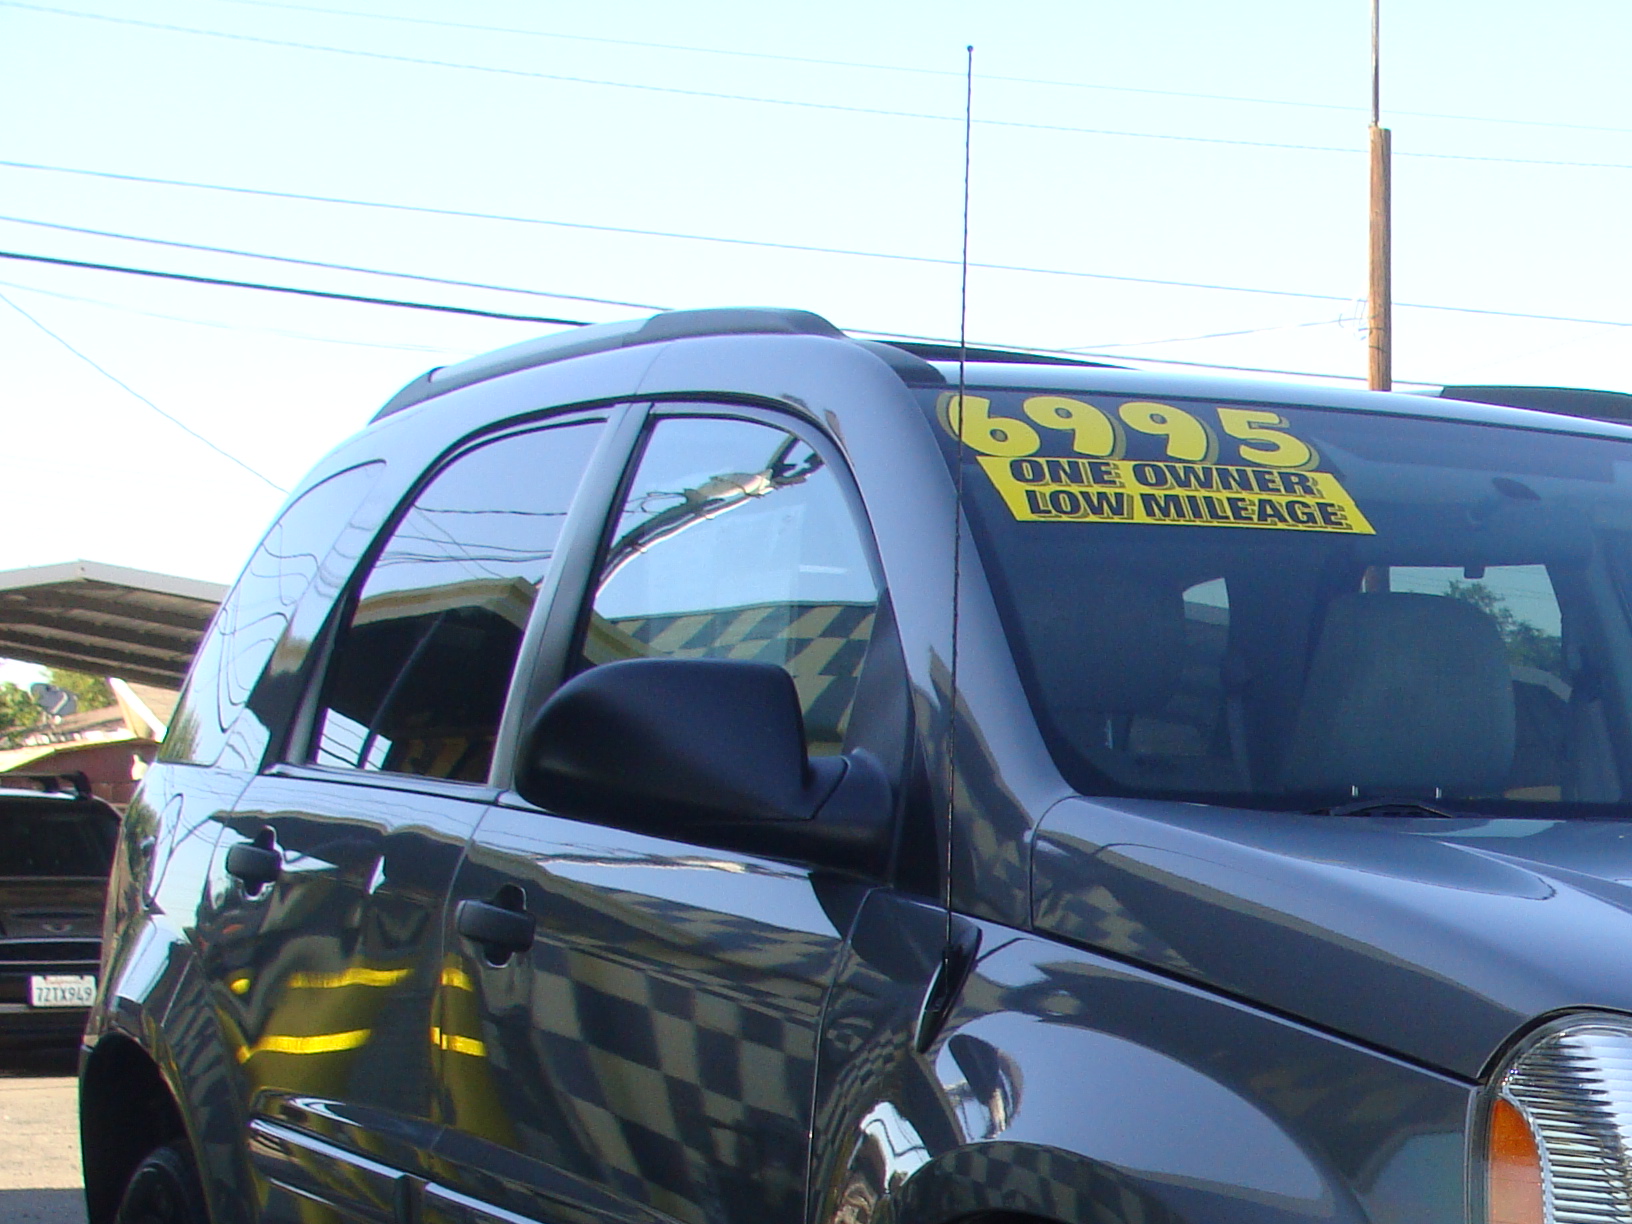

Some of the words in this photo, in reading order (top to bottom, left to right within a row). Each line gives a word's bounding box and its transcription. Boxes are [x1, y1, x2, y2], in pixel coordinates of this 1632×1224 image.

[937, 391, 1320, 471] 6995
[1009, 458, 1126, 489] ONE
[1132, 462, 1325, 498] OWNER
[1025, 489, 1135, 520] LOW
[1144, 493, 1354, 531] MILEAGE
